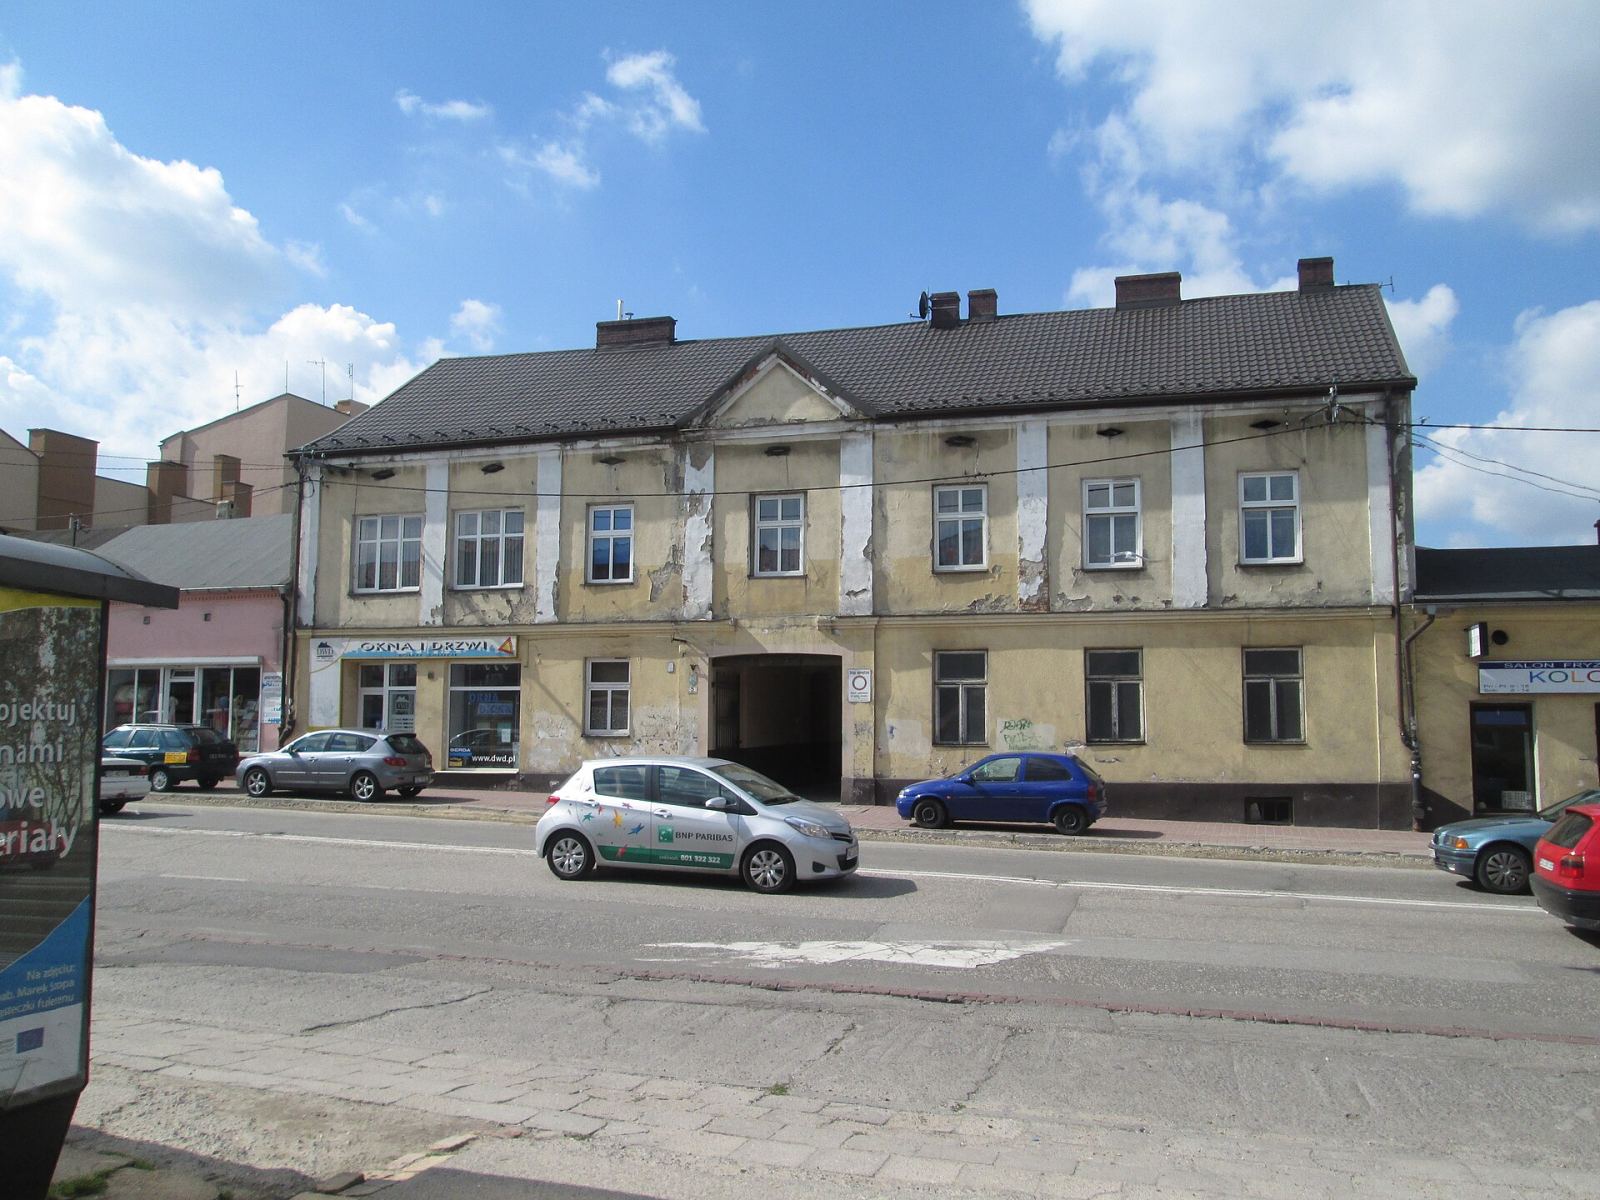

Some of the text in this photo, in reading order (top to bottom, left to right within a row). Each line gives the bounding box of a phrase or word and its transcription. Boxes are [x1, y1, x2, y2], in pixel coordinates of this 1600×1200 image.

[361, 641, 488, 652] OKNA I DRZWI
[0, 733, 65, 764] nami
[472, 755, 516, 764] www.dwd.pl
[696, 833, 733, 842] PARIBAS
